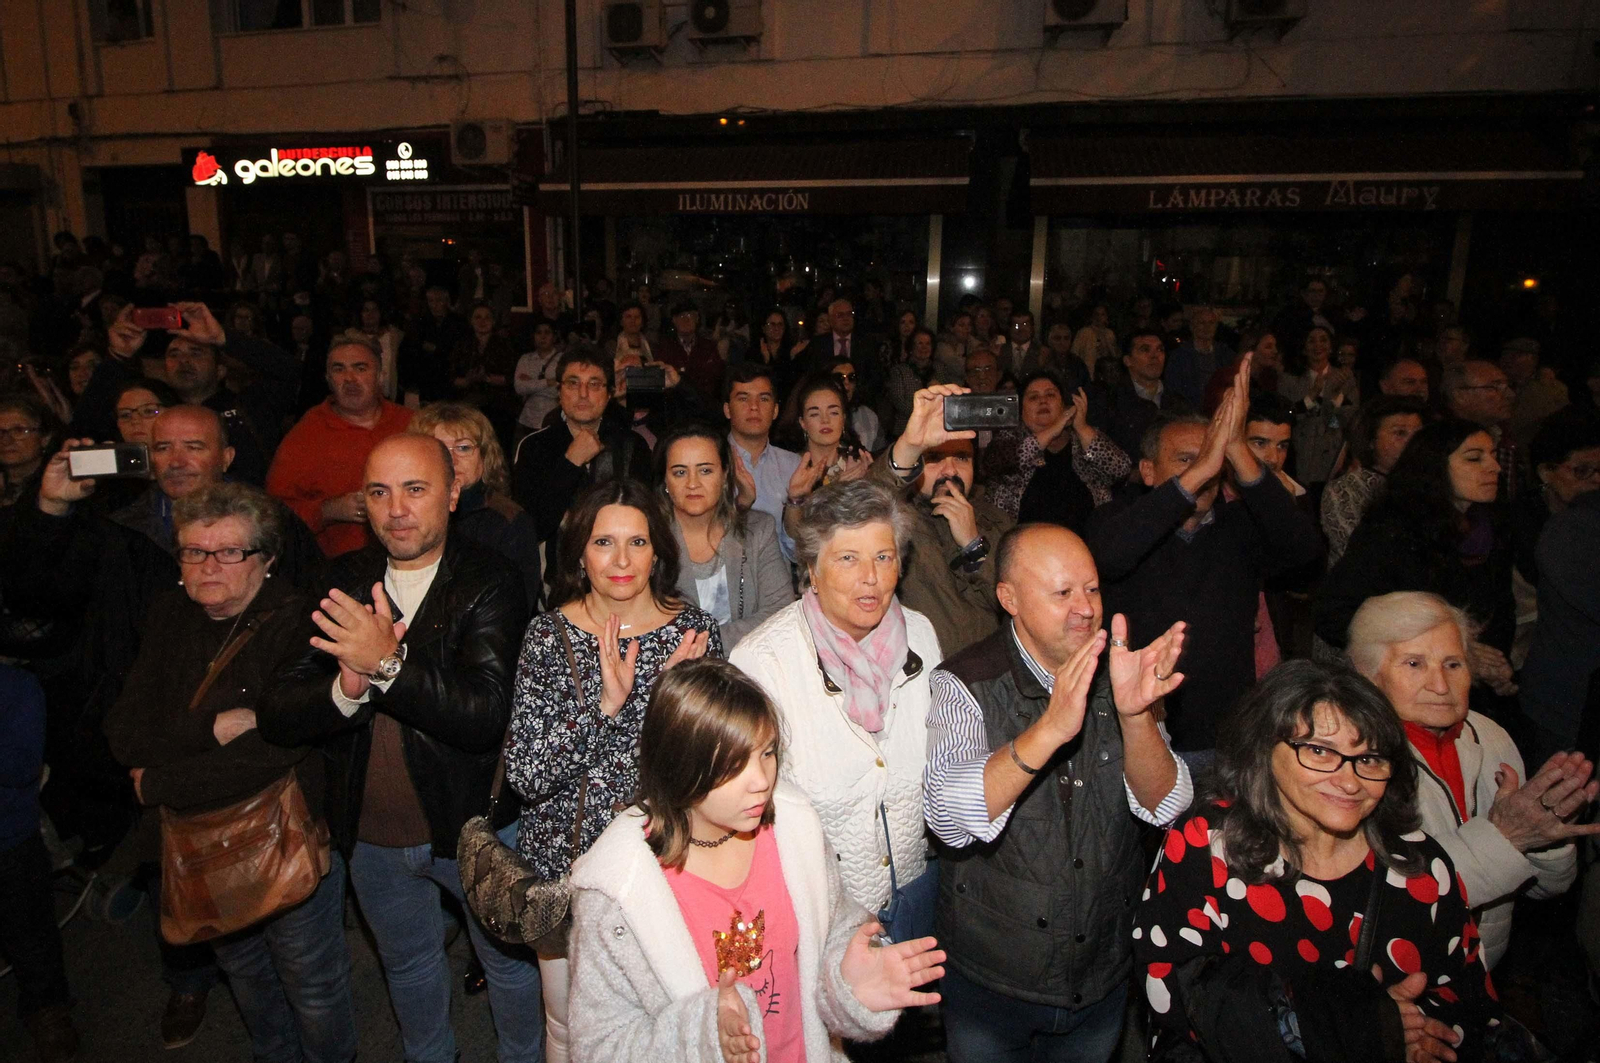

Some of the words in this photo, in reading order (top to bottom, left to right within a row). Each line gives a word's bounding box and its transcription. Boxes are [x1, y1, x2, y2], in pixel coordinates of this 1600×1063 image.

[278, 147, 373, 159] AUTOESCUELA
[234, 148, 376, 185] galeones
[677, 189, 810, 211] ILUMINACIÓN
[1148, 186, 1301, 210] LÁMPARAS
[1324, 181, 1440, 210] Maury
